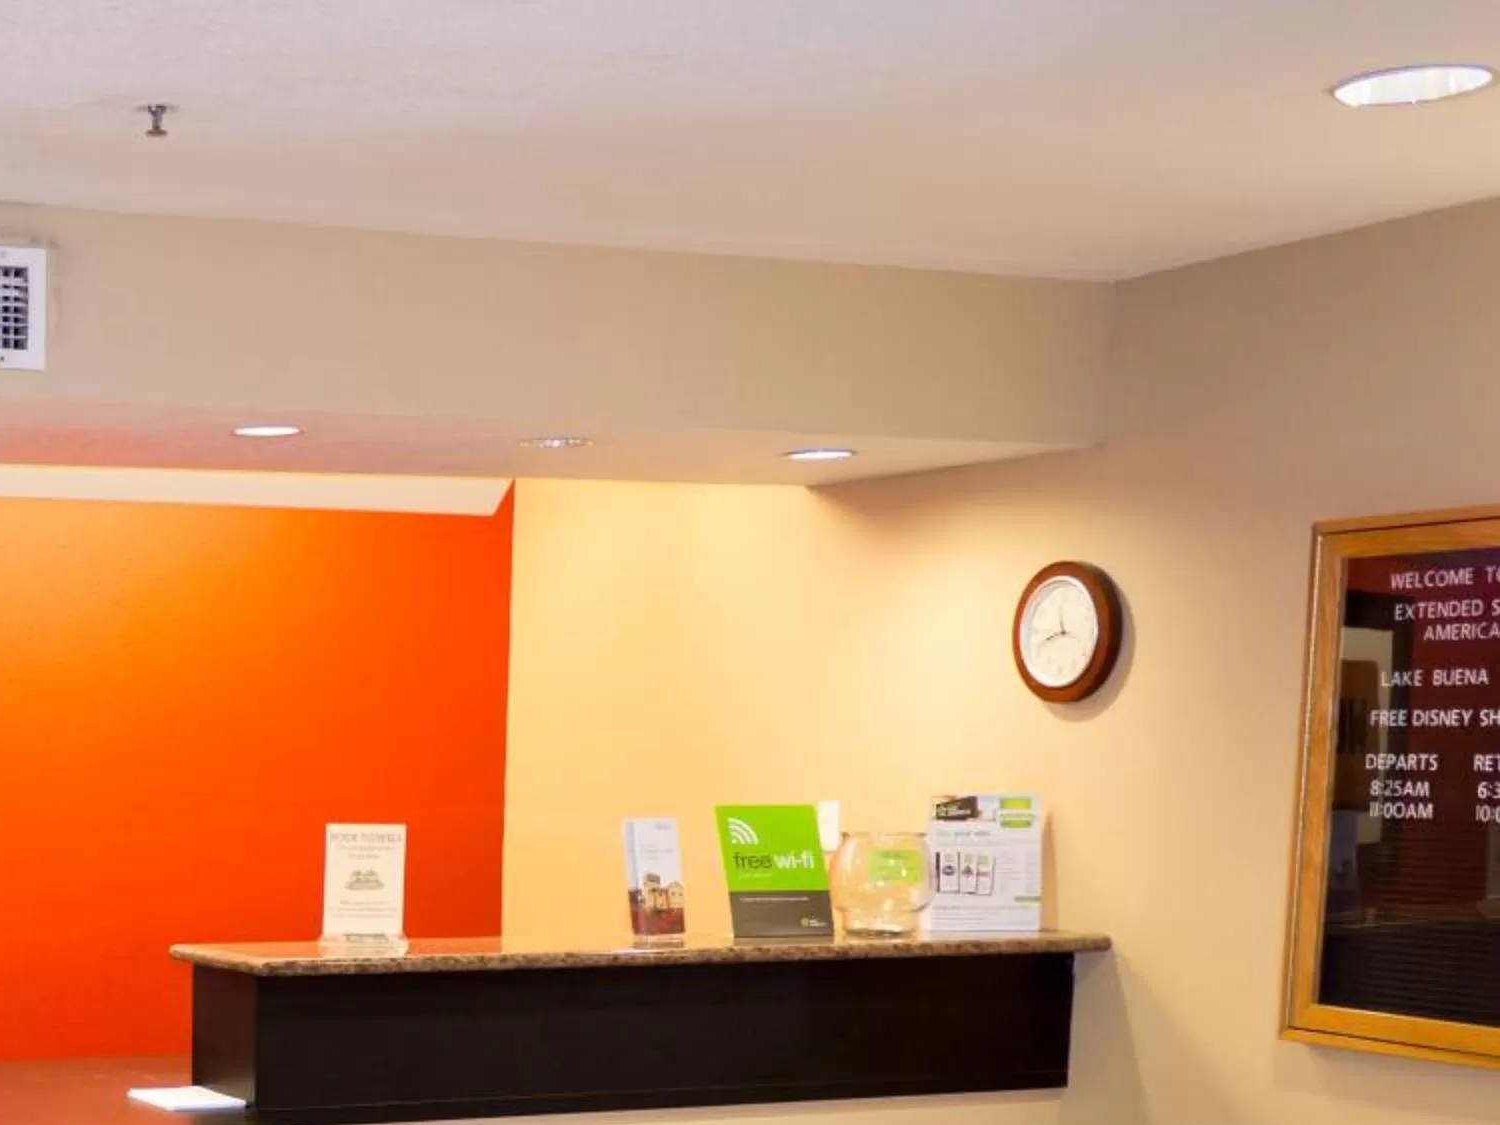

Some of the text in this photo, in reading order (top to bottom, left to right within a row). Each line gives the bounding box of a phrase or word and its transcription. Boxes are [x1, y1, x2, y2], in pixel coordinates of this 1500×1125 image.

[1390, 568, 1475, 590] WELCOME
[1394, 599, 1484, 620] EXTENDED
[1423, 622, 1500, 641] AMERICA
[1380, 668, 1489, 688] LAKE BUENA
[1370, 709, 1408, 727] FREE
[1411, 708, 1473, 727] DISNEY
[1364, 753, 1439, 771] DEPARTS
[1369, 780, 1431, 797] 8:25AM
[1369, 802, 1434, 819] 11:00AM
[732, 850, 816, 869] free wi-fi
